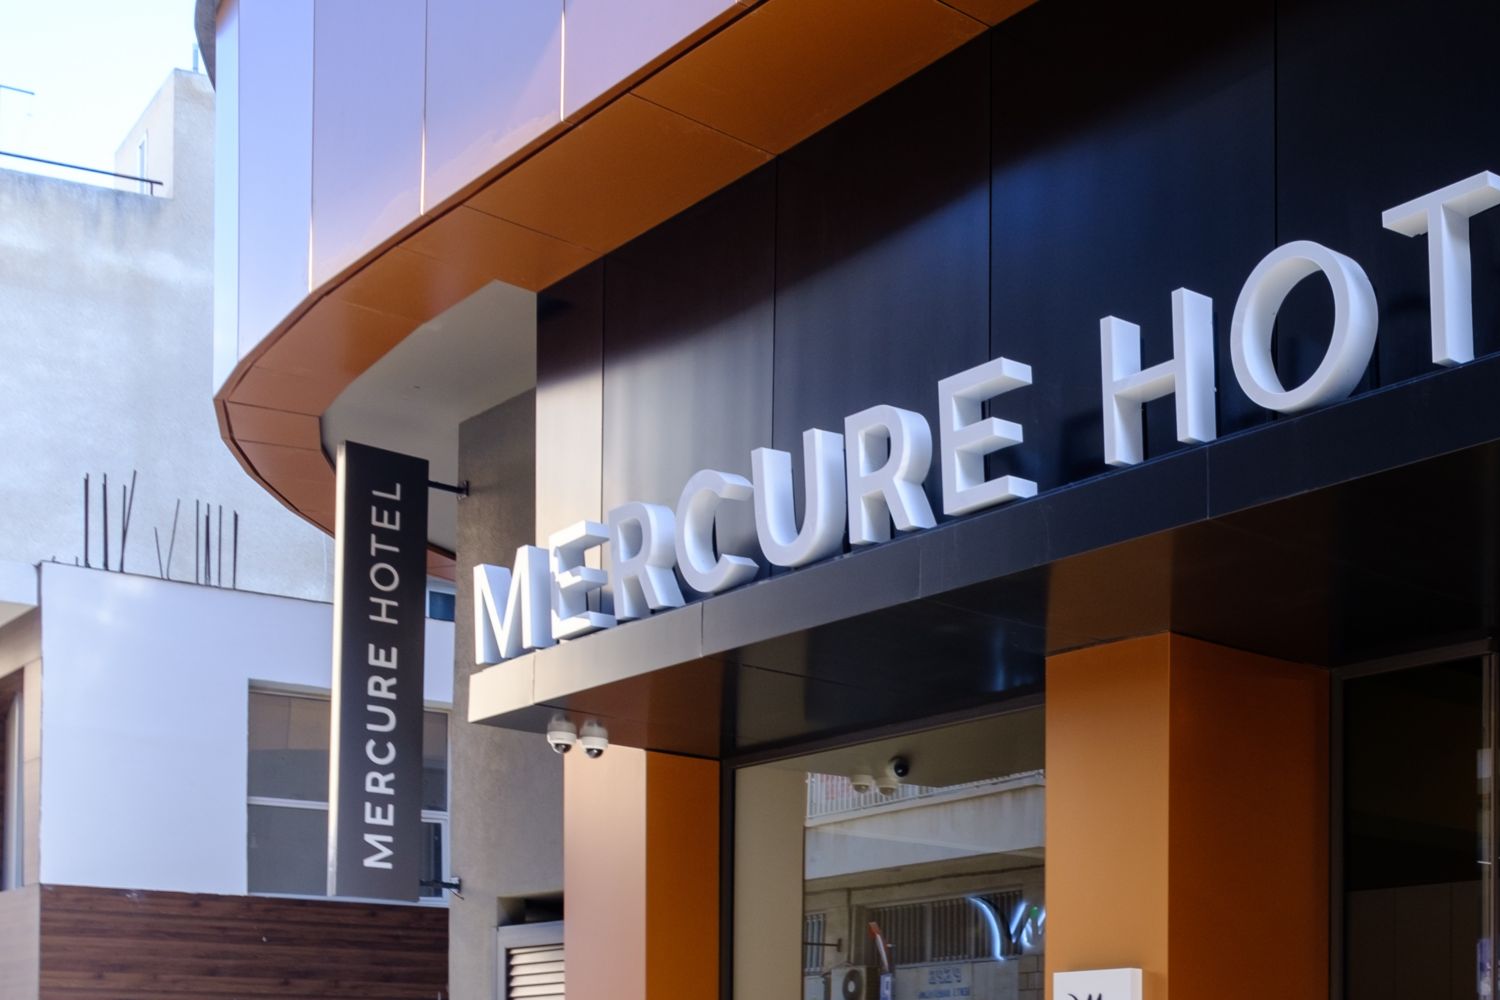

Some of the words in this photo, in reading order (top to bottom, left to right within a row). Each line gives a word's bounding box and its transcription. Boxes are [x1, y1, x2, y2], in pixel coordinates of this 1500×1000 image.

[369, 481, 401, 625] HOTEL
[473, 356, 1038, 665] MERCURE
[363, 642, 398, 870] MERCURE
